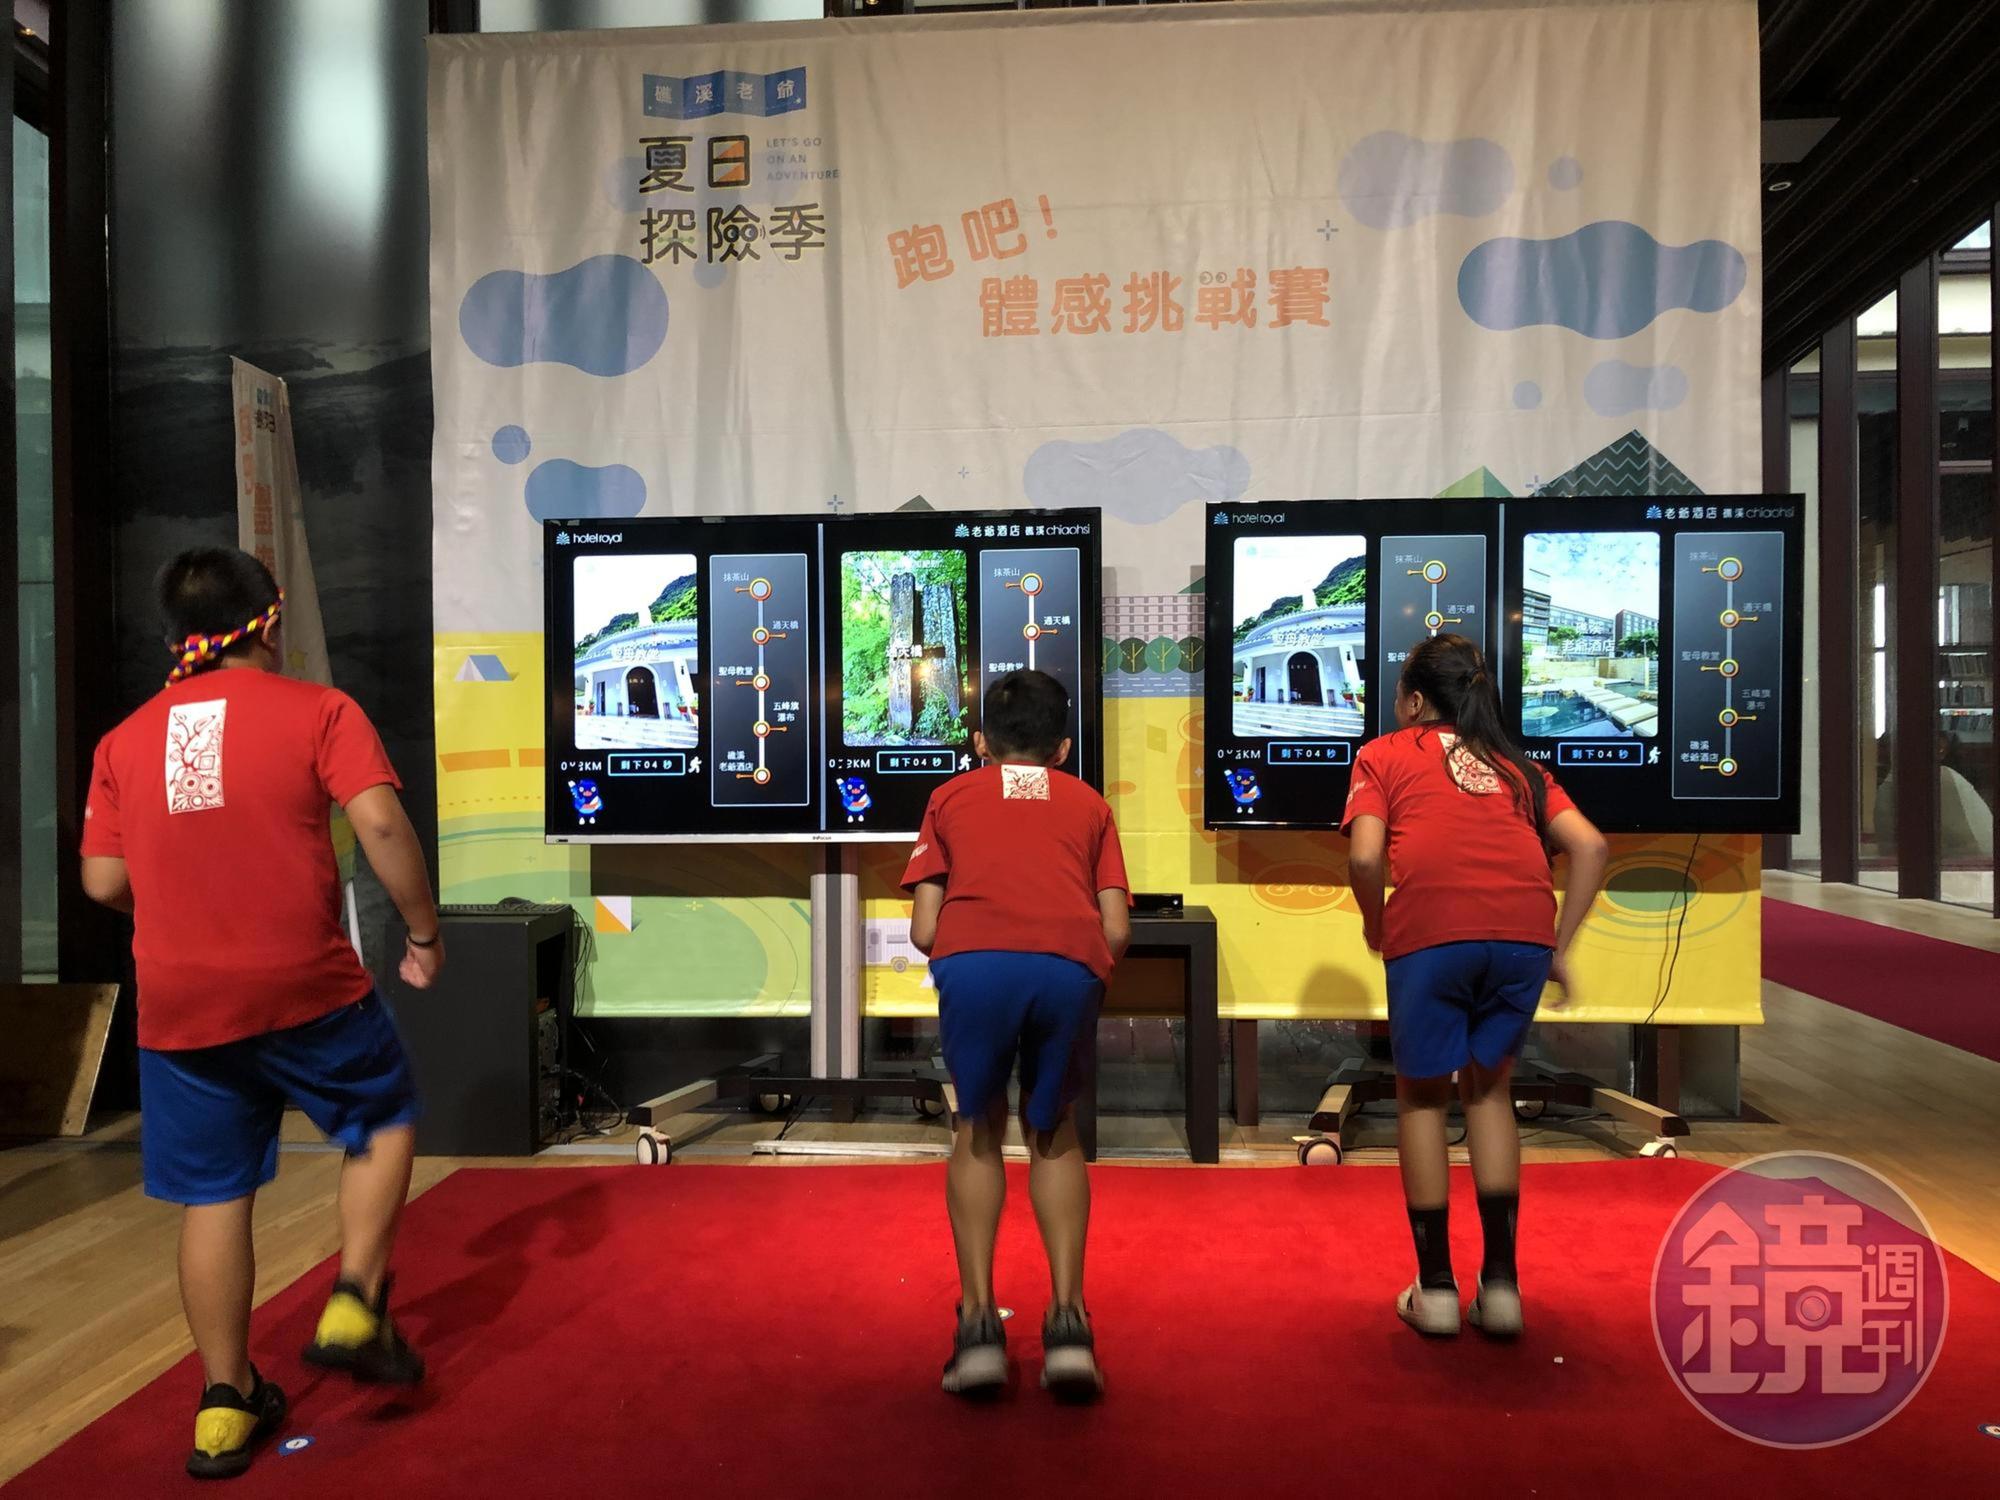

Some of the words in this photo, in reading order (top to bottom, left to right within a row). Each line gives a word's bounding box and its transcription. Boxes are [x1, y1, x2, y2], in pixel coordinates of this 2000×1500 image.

[654, 79, 795, 104] 礁溪老爺
[766, 137, 799, 148] LET'S
[803, 137, 822, 147] GO
[638, 134, 751, 193] 夏日
[766, 155, 785, 164] ON
[790, 154, 807, 163] AN
[767, 169, 840, 180] ADVENTURE
[639, 203, 826, 264] 探險季
[979, 265, 1331, 338] 體感挑戰賽
[971, 525, 1020, 538] 老爺酒店
